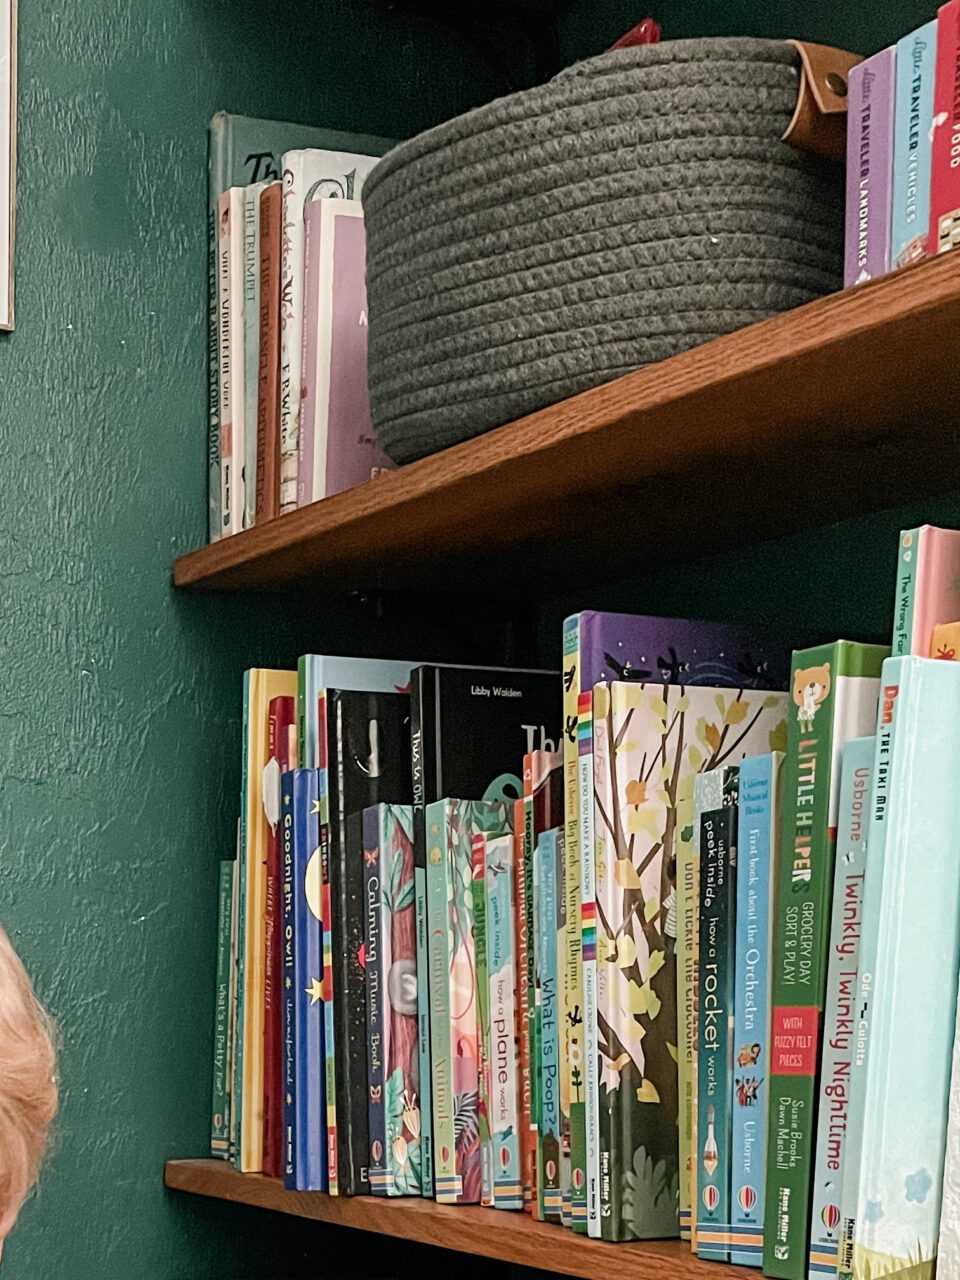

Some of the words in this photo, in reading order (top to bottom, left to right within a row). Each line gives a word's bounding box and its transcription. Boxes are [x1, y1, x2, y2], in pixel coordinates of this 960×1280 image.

[209, 370, 219, 418] STORY
[210, 424, 220, 467] BOOK
[471, 685, 491, 697] Libby
[492, 686, 522, 697] Walden
[797, 739, 817, 806] LITTLE
[850, 768, 870, 842] Usborne
[704, 820, 717, 859] peek
[748, 828, 759, 855] First
[792, 811, 814, 894] HELPERS
[717, 840, 726, 885] usborne
[748, 859, 759, 884] book
[704, 863, 718, 907] inside
[366, 876, 379, 962] Calming
[490, 896, 500, 926] peek
[748, 889, 759, 920] about
[785, 906, 798, 935] SORT
[475, 902, 487, 968] JUNGLE
[708, 918, 719, 945] how
[747, 925, 758, 943] the
[785, 940, 795, 948] &
[799, 902, 815, 958] GROCERY
[492, 930, 501, 966] inside
[709, 948, 717, 957] a
[782, 951, 796, 985] PLAY!
[798, 960, 812, 984] DAY
[860, 972, 872, 997] Ode
[370, 971, 379, 1025] Music
[497, 979, 506, 1004] how
[543, 978, 556, 1030] What
[744, 948, 761, 1030] Orchestra
[498, 1007, 505, 1015] a
[705, 964, 722, 1051] rocket
[782, 1016, 803, 1030] WITH
[830, 968, 859, 1050] Twinkly
[370, 1034, 380, 1073] Book
[493, 1019, 510, 1084] plane
[543, 1040, 556, 1055] is
[775, 1035, 795, 1048] FUZZY
[796, 1035, 815, 1048] FELT
[855, 1020, 869, 1066] Culotta
[707, 1055, 717, 1096] works
[779, 1054, 803, 1067] PIECES
[499, 1088, 508, 1120] works
[543, 1063, 557, 1126] Poop?
[791, 1100, 804, 1128] Susie
[825, 1062, 851, 1170] Nighttime
[601, 1152, 610, 1173] Kane
[743, 1121, 755, 1173] Usborne
[788, 1132, 802, 1167] Brooks
[601, 1175, 609, 1200] Miller
[845, 1217, 856, 1241] Kane
[844, 1243, 854, 1268] Miller
